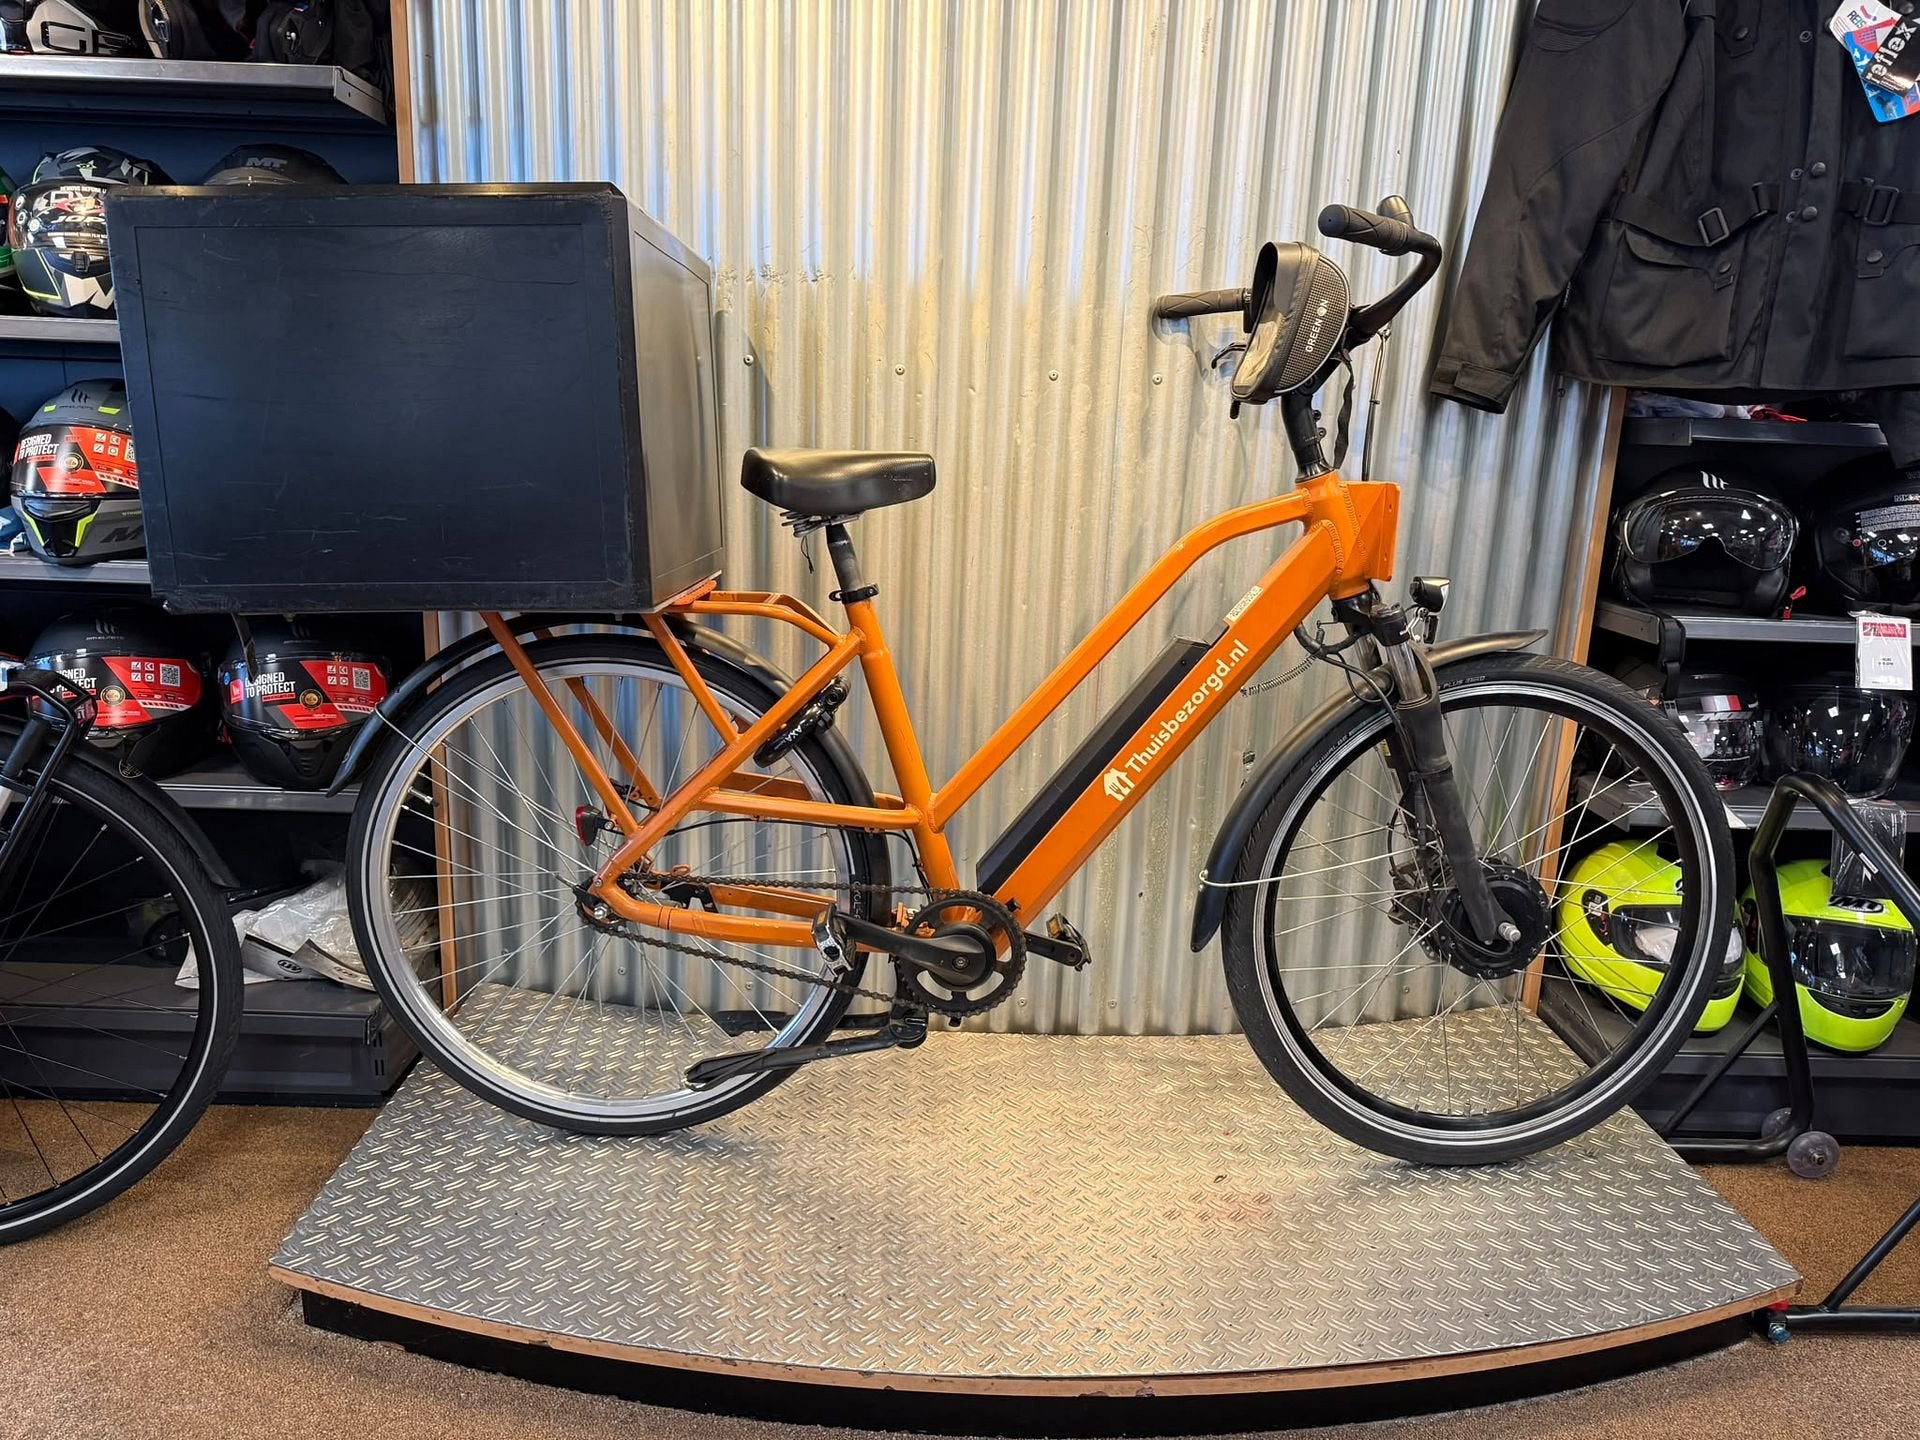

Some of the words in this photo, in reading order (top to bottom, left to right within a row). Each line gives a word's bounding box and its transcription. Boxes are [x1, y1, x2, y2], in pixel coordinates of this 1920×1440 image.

[1866, 22, 1917, 84] reflex
[1305, 317, 1323, 353] GREEN
[25, 443, 60, 459] PROTECT
[245, 672, 285, 688] DSIGNED
[256, 681, 296, 696] PROTECT
[1124, 638, 1250, 774] Thuisbezorgd.nl
[785, 724, 803, 742] AXA
